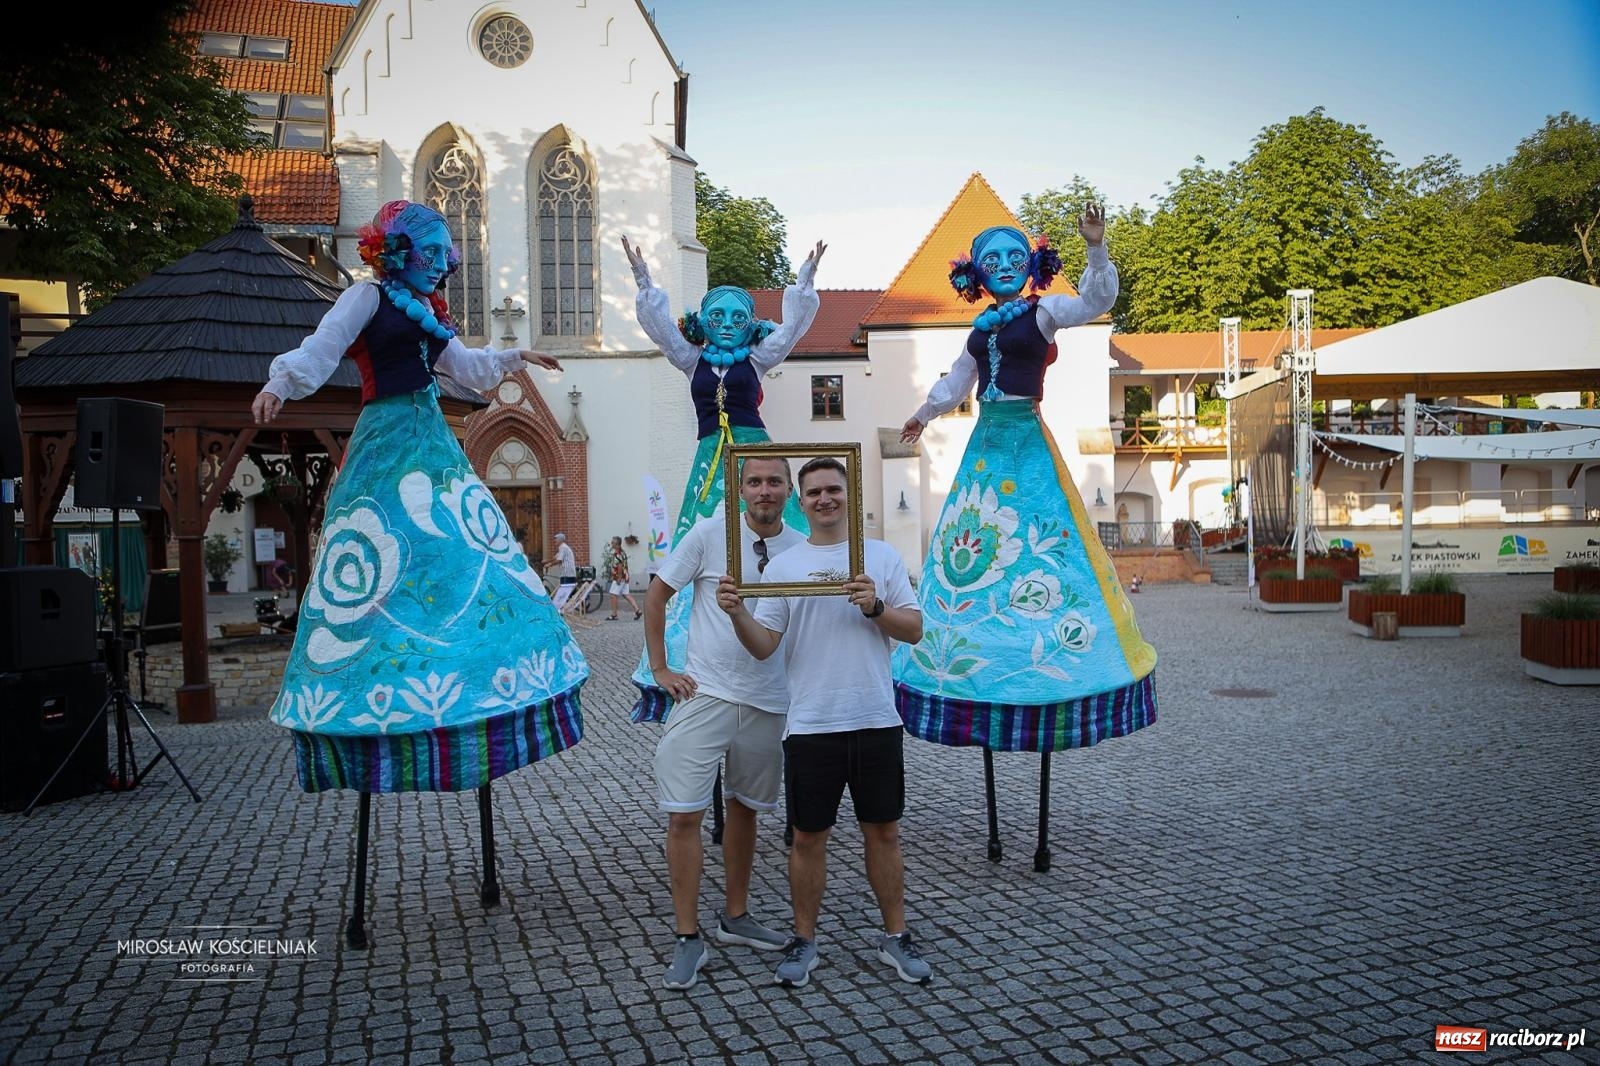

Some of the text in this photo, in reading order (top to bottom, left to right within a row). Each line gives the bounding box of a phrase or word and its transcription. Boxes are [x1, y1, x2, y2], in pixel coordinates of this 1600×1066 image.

[242, 474, 254, 487] D
[1391, 552, 1481, 562] ZAEK PIASTOWSKI
[1566, 550, 1598, 559] ZAMEK
